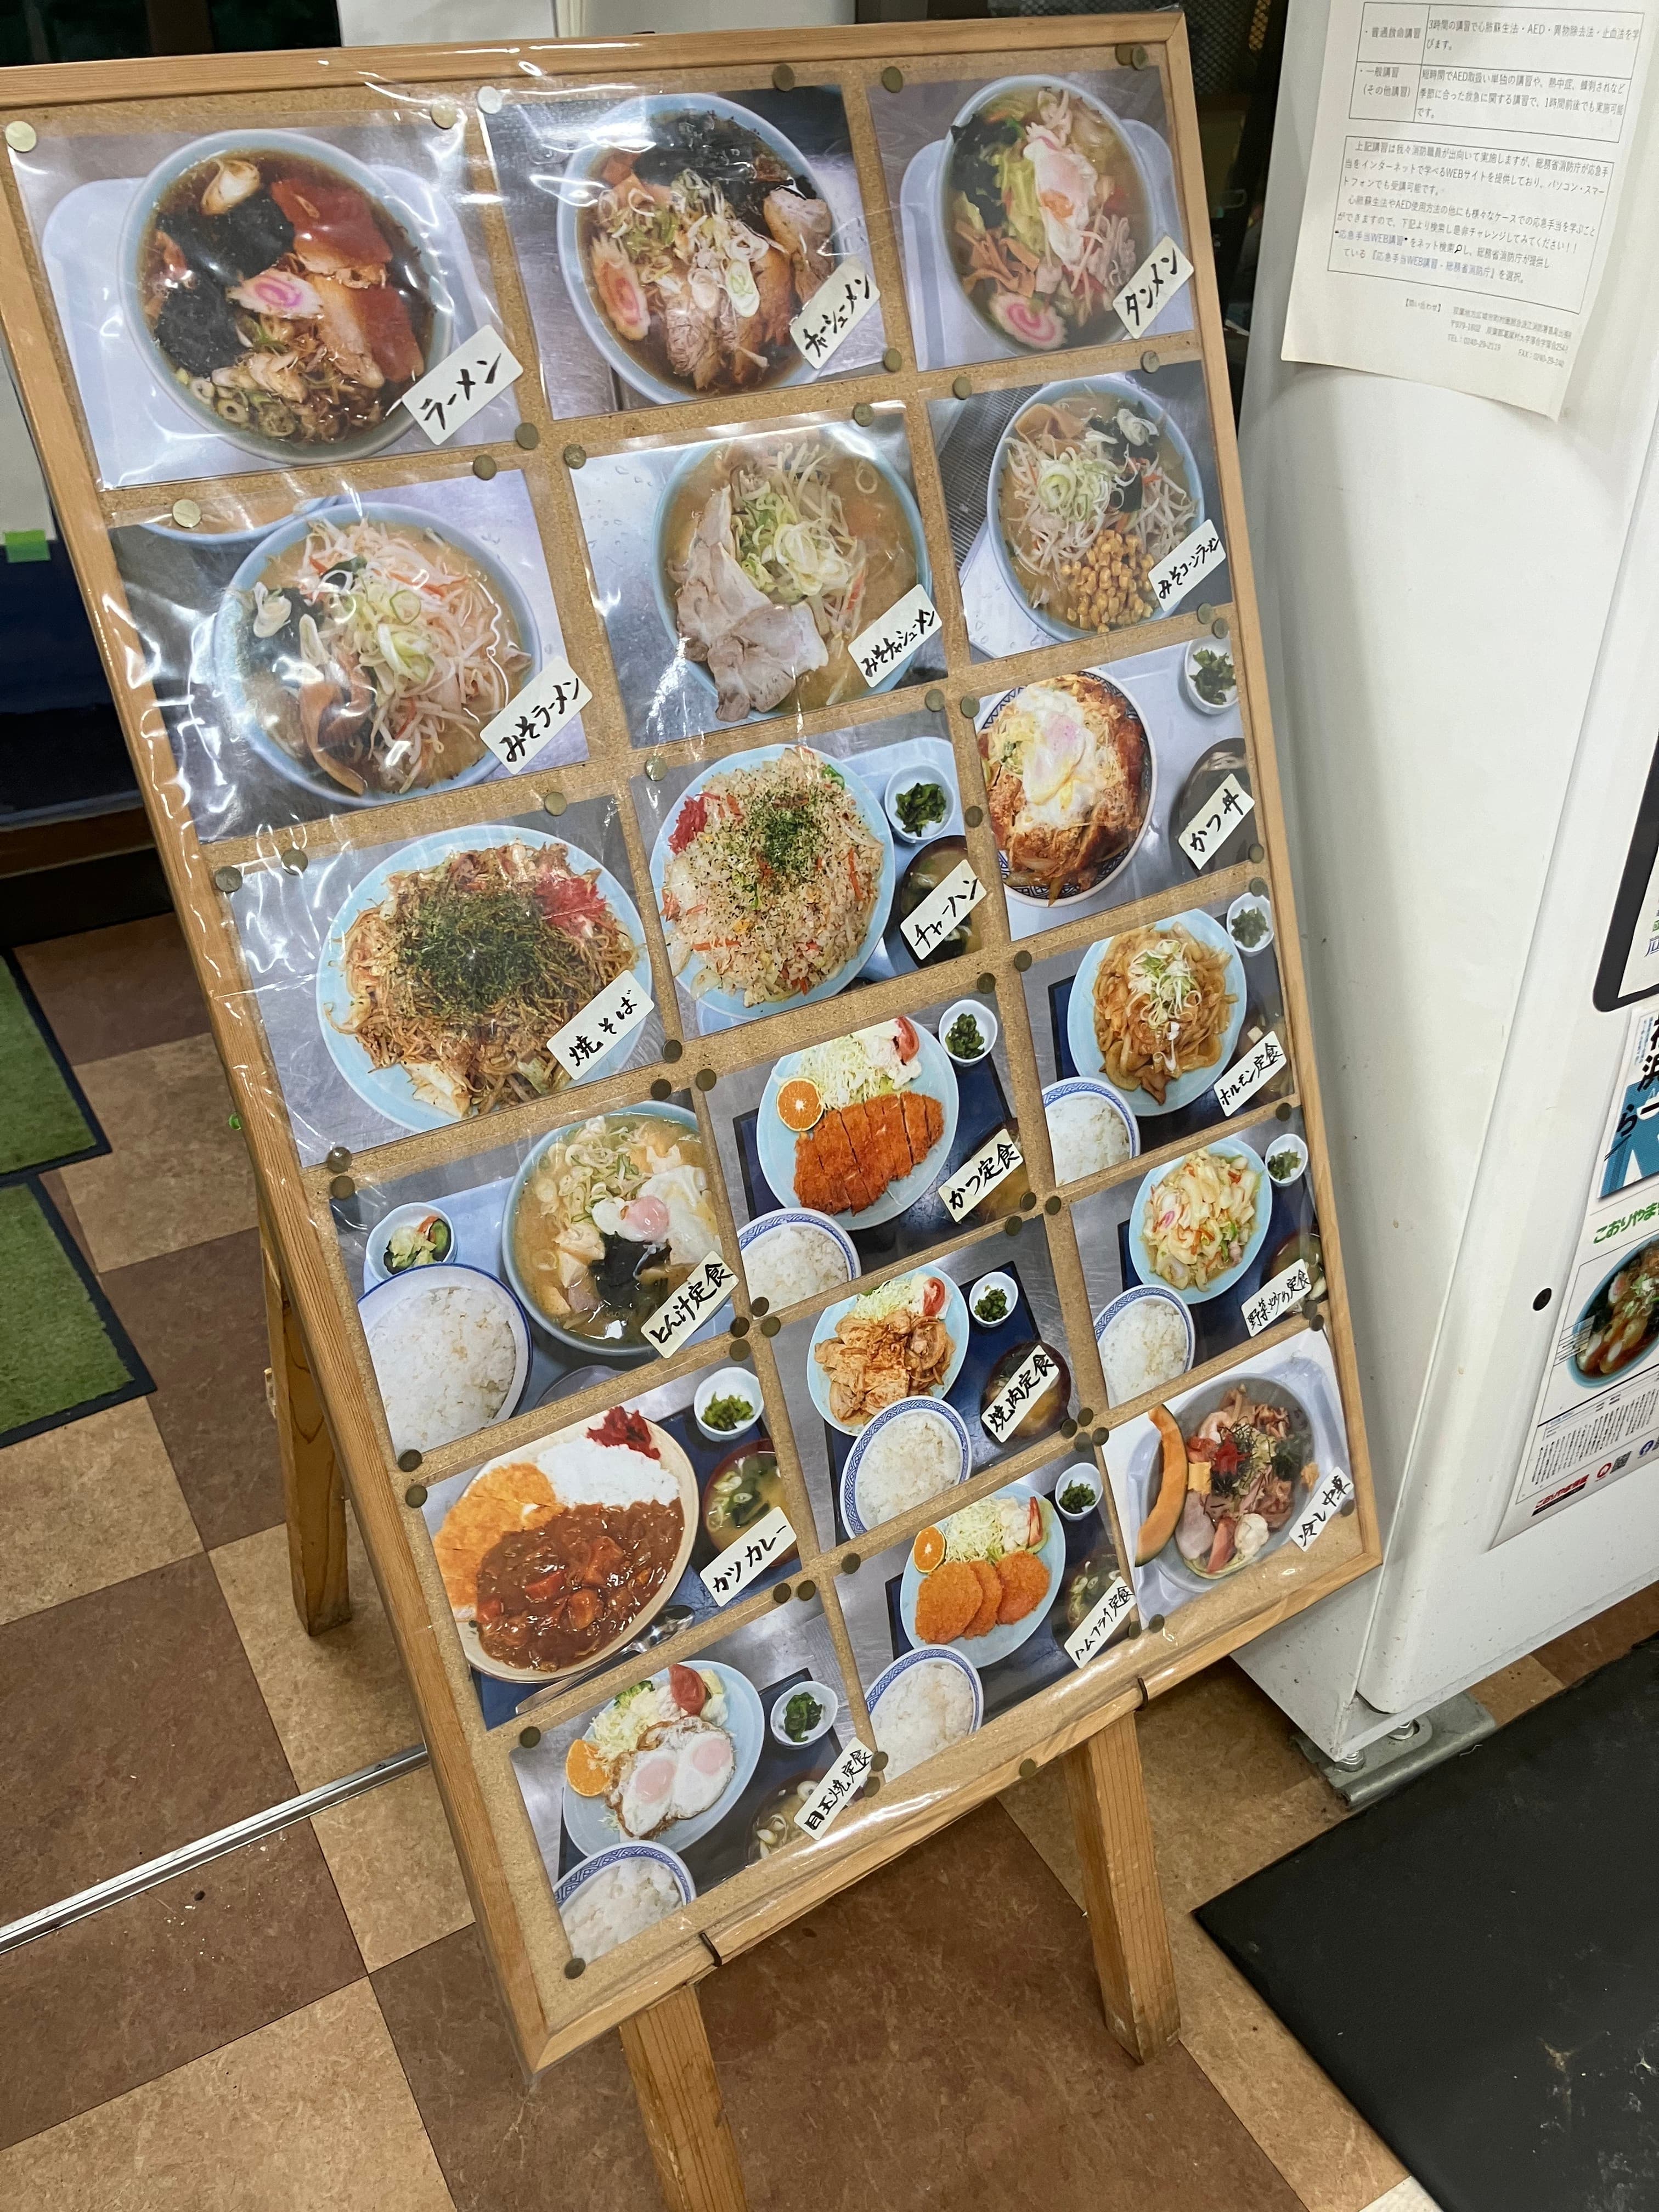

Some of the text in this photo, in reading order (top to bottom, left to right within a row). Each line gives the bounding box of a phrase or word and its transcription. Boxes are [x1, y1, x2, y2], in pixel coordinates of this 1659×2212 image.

[804, 273, 870, 357] チャーシューメン
[1125, 247, 1177, 325] タンメン
[420, 353, 501, 430] ラーメン
[499, 678, 579, 761] みそラーメン
[1190, 789, 1244, 853] かつ丼
[915, 877, 979, 949] チャーハン
[569, 990, 637, 1066] 焼そば
[1220, 1043, 1283, 1106] ホルモン定食
[949, 1143, 1019, 1210] かつ定食
[1593, 1203, 1659, 1244] こおりやま
[649, 1263, 733, 1344] とん汁定食
[1248, 1269, 1310, 1329] 野菜炒め定食
[989, 1353, 1054, 1432] 焼肉定食
[1300, 1475, 1349, 1546] 冷し中華
[1075, 1585, 1134, 1661] ハムフライ定食
[804, 1750, 873, 1831] 目玉焼定食
